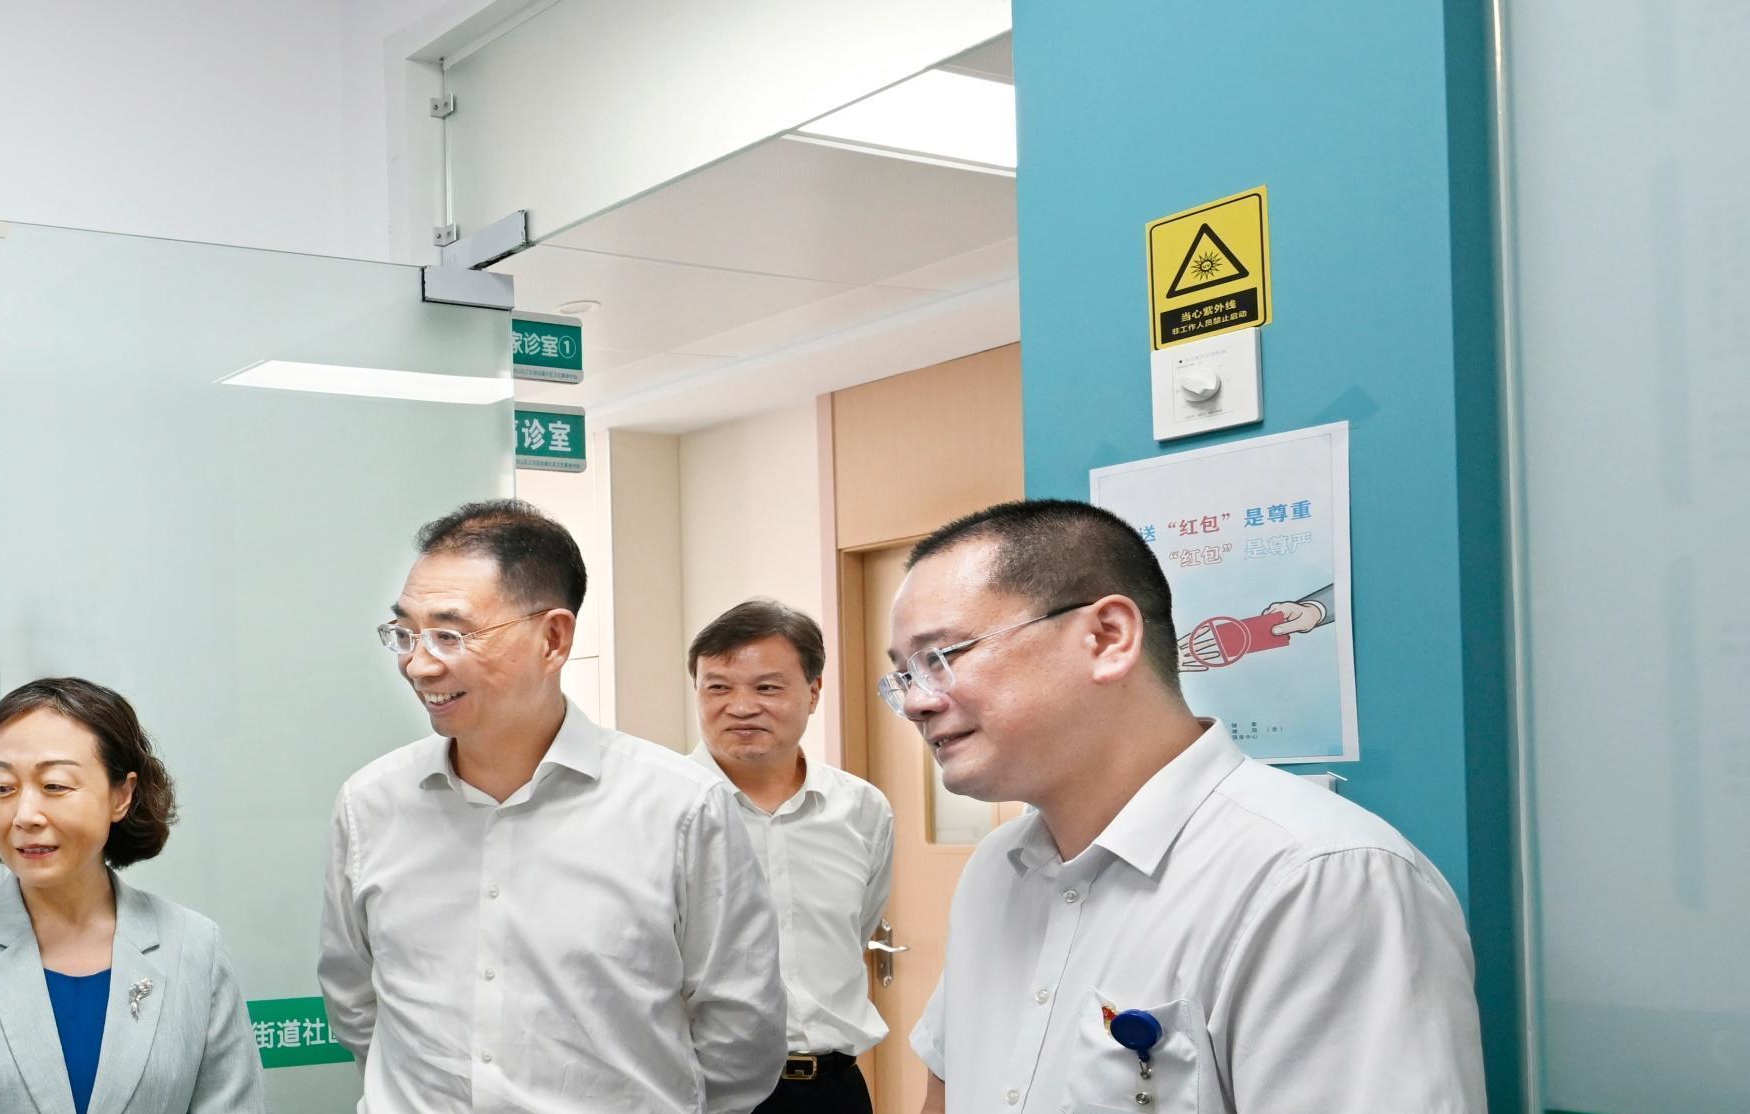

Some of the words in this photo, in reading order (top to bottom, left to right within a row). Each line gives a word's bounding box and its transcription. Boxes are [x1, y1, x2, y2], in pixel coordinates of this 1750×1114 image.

[1171, 310, 1248, 335] 非工作人员禁止启动
[1181, 299, 1237, 322] 当心紫外线
[514, 418, 571, 452] 诊室
